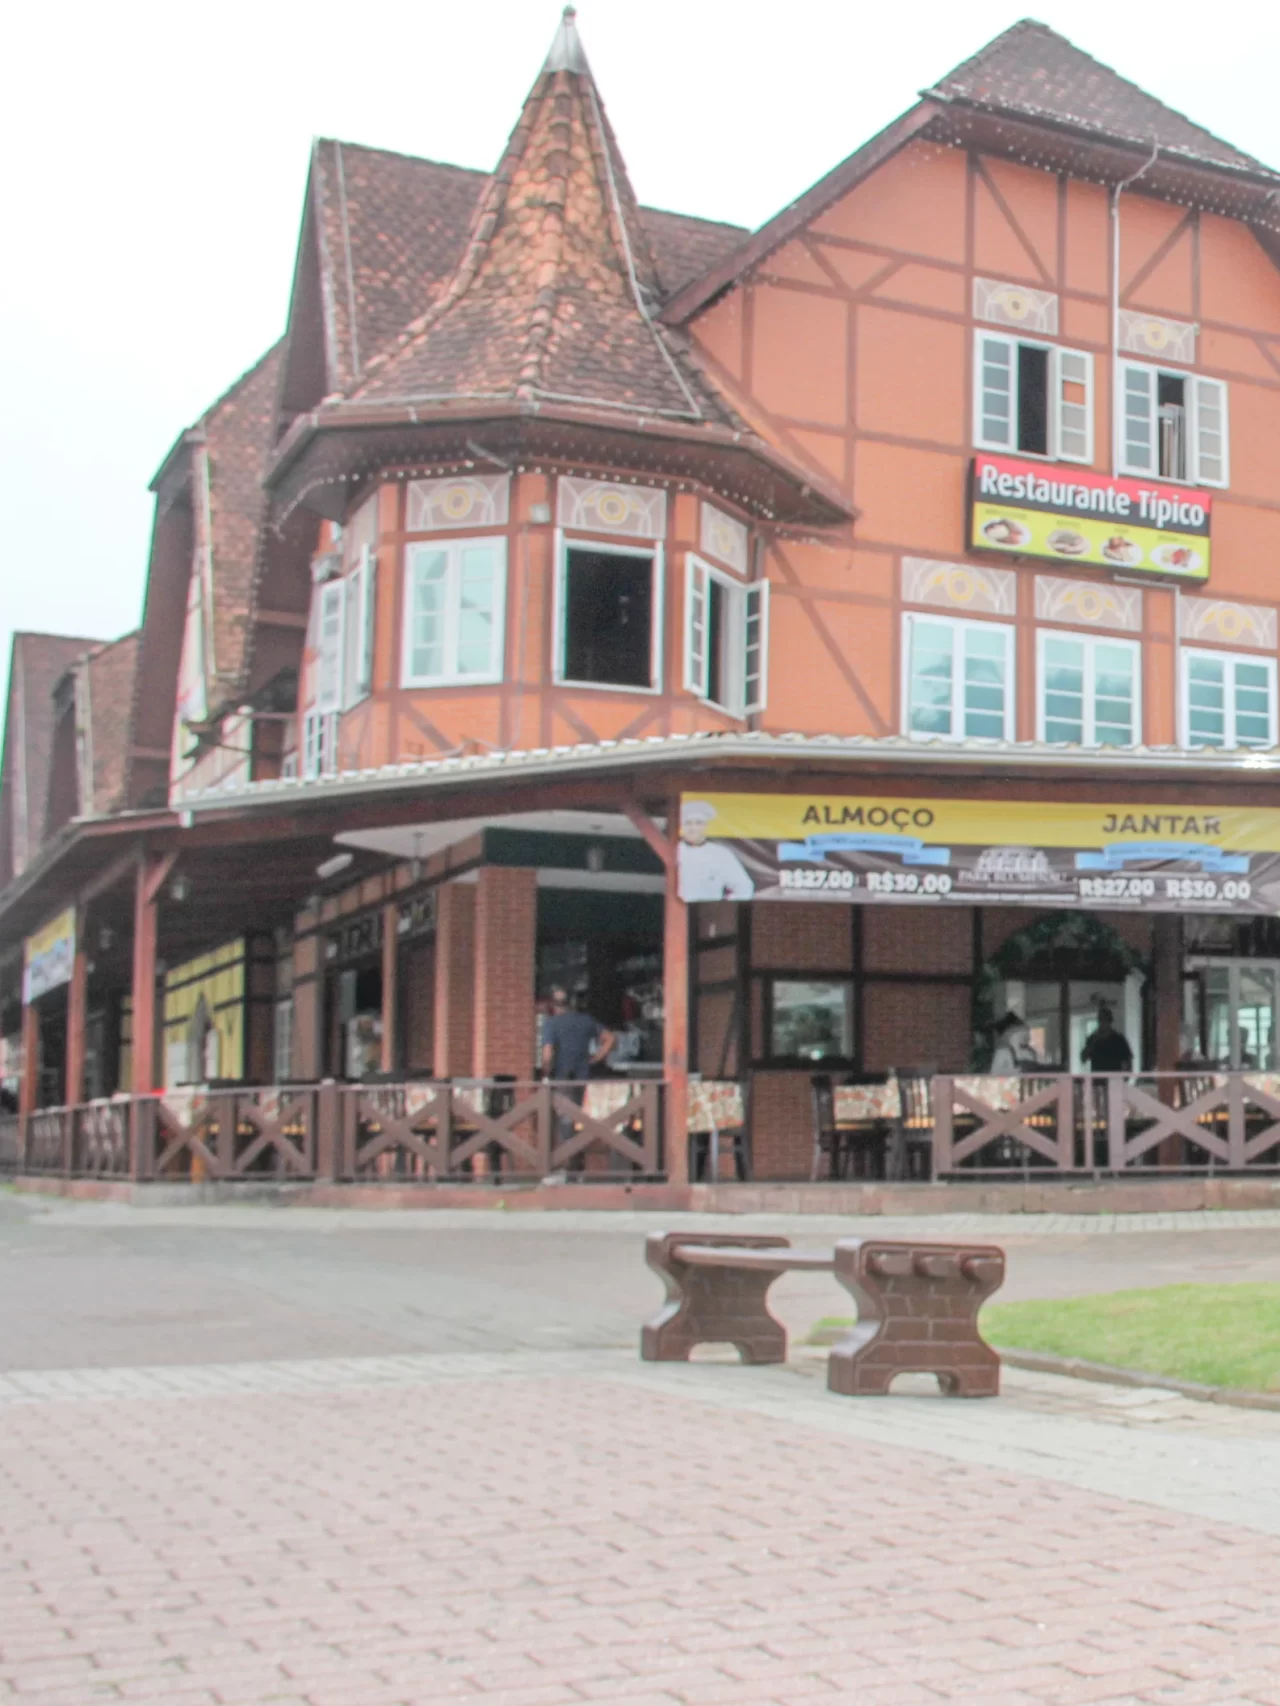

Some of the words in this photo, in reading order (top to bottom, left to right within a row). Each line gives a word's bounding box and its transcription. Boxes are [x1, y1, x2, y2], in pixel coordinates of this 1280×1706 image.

[980, 464, 1130, 516] Restaurante
[1137, 489, 1205, 528] Típico
[802, 804, 935, 832] ALMOÇO
[1102, 813, 1221, 835] JANTAR
[778, 868, 855, 889] R$27,00
[866, 871, 953, 894] R$30,00
[1078, 876, 1156, 897] R$27,00
[1165, 878, 1252, 900] R$30,00
